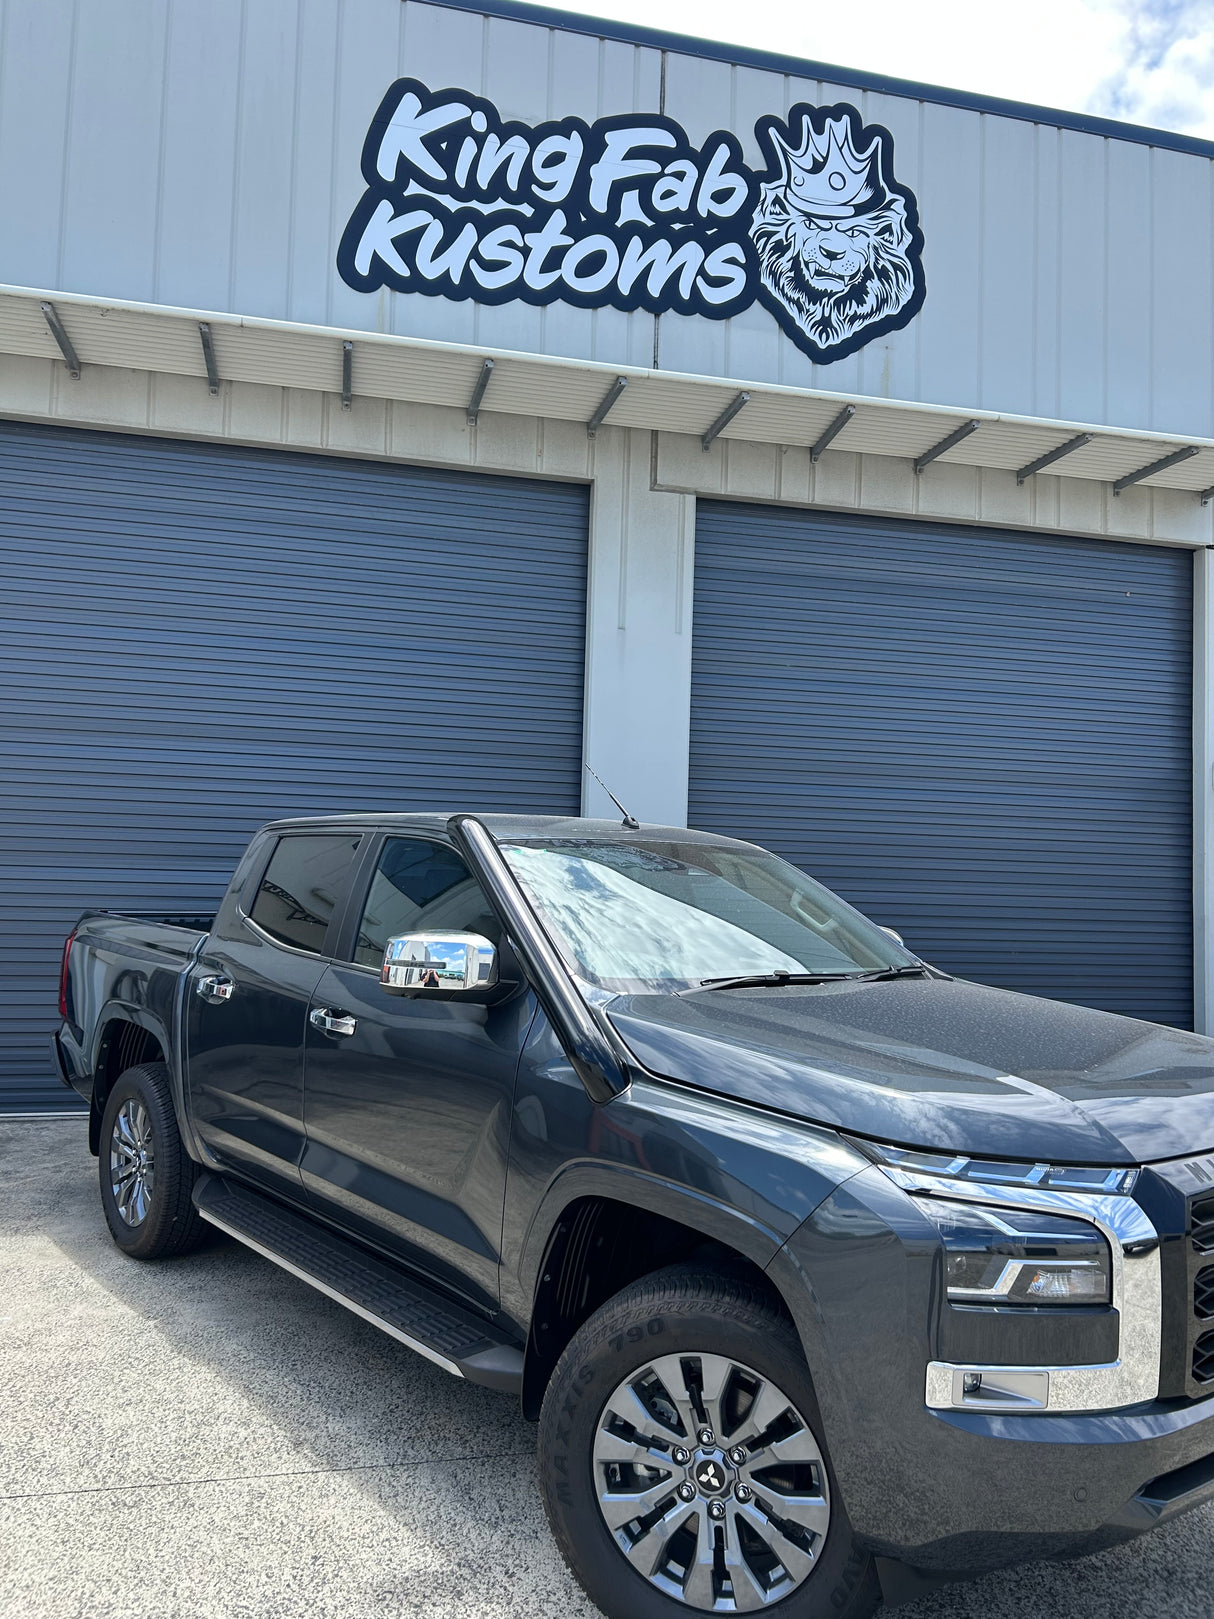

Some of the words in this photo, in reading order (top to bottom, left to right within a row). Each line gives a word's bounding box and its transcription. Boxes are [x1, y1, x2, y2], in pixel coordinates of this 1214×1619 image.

[376, 92, 583, 201] King
[589, 127, 747, 218] Fab
[608, 1317, 666, 1353] 790
